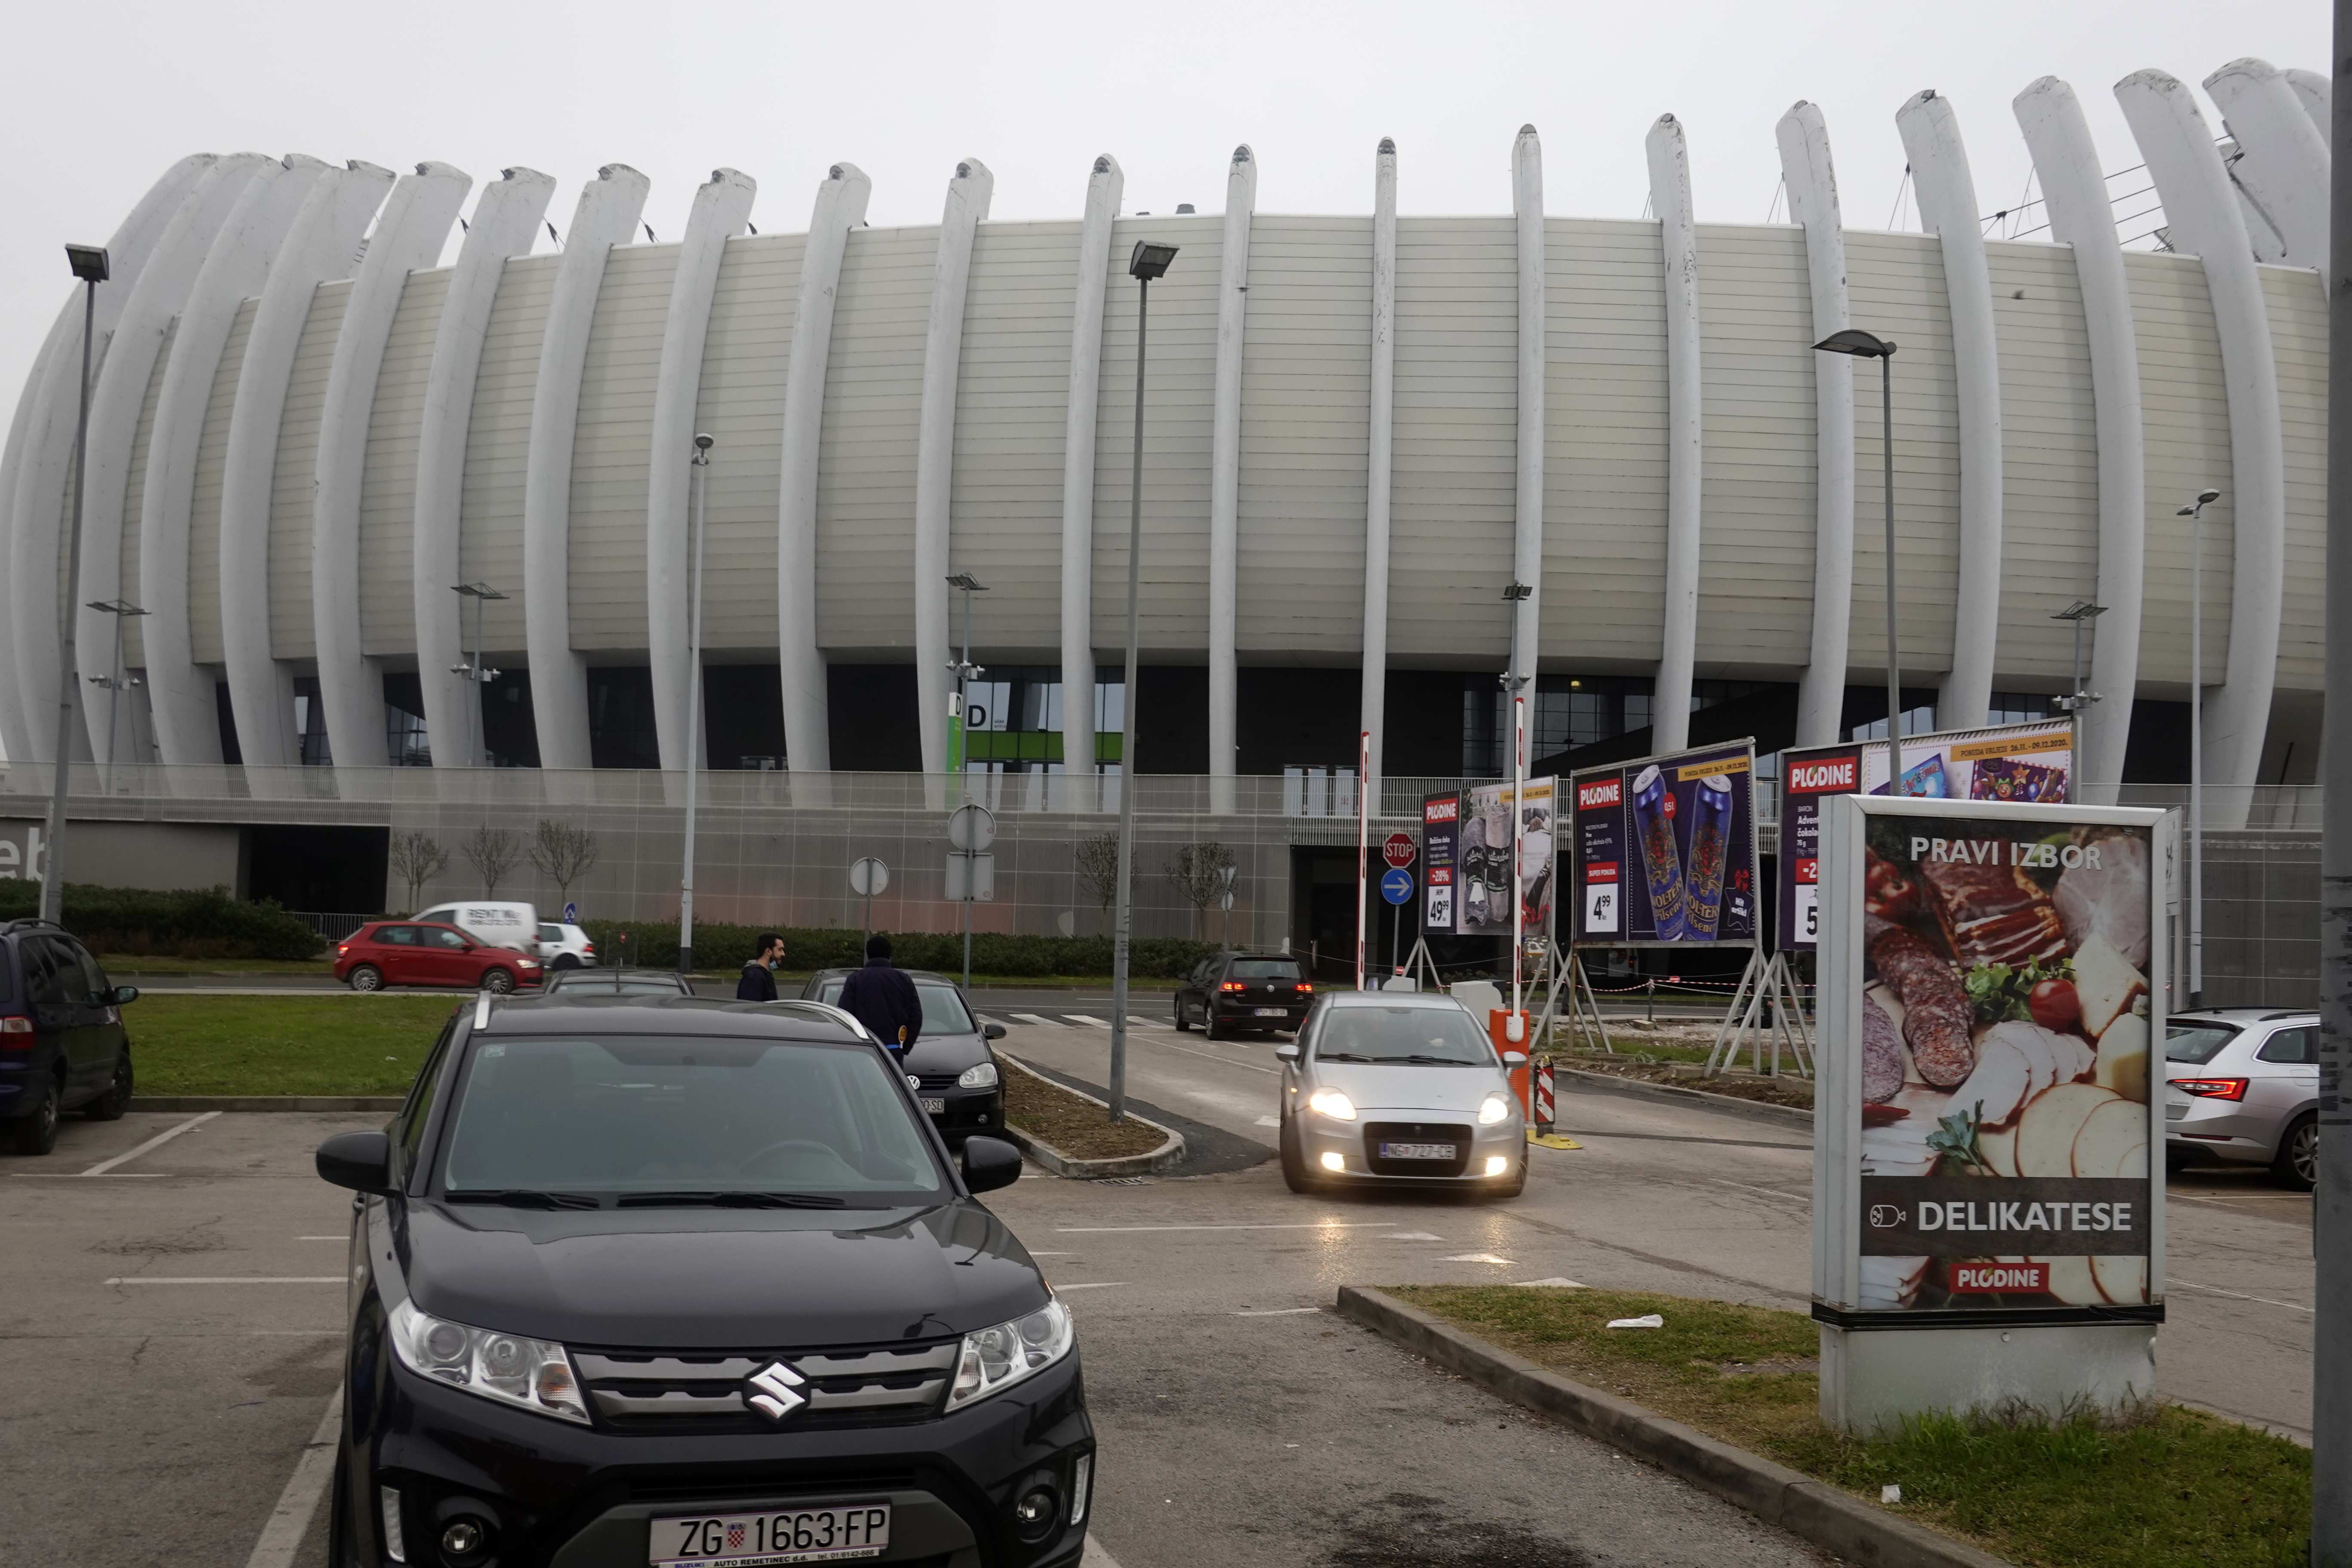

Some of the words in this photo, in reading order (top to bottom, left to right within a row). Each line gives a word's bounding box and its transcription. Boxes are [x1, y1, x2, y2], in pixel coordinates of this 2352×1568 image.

[956, 696, 961, 715] D
[968, 705, 986, 727] D
[1985, 746, 2007, 755] VRIJEDI
[2010, 744, 2027, 752] 26.11.
[2032, 739, 2068, 749] 09.12.2020.
[1792, 764, 1853, 788] PLODINE
[1580, 784, 1619, 806] PLODINE
[1427, 803, 1456, 820] PLODINE
[1798, 827, 1818, 837] čokola
[1386, 843, 1413, 858] STOP
[1911, 837, 1999, 865] PRAVI
[2011, 842, 2102, 870] IZBOR
[1803, 862, 1817, 878] -2
[1653, 877, 1681, 908] OLTER
[1687, 892, 1718, 918] OLTER
[920, 1100, 943, 1110] 0-SD
[1918, 1201, 2132, 1231] DELIKATESE
[1957, 1269, 2040, 1288] PLODINE
[679, 1519, 723, 1556] ZG
[714, 1559, 738, 1568] AUTO
[741, 1556, 791, 1565] REMETINEC
[793, 1554, 808, 1562] d.d.
